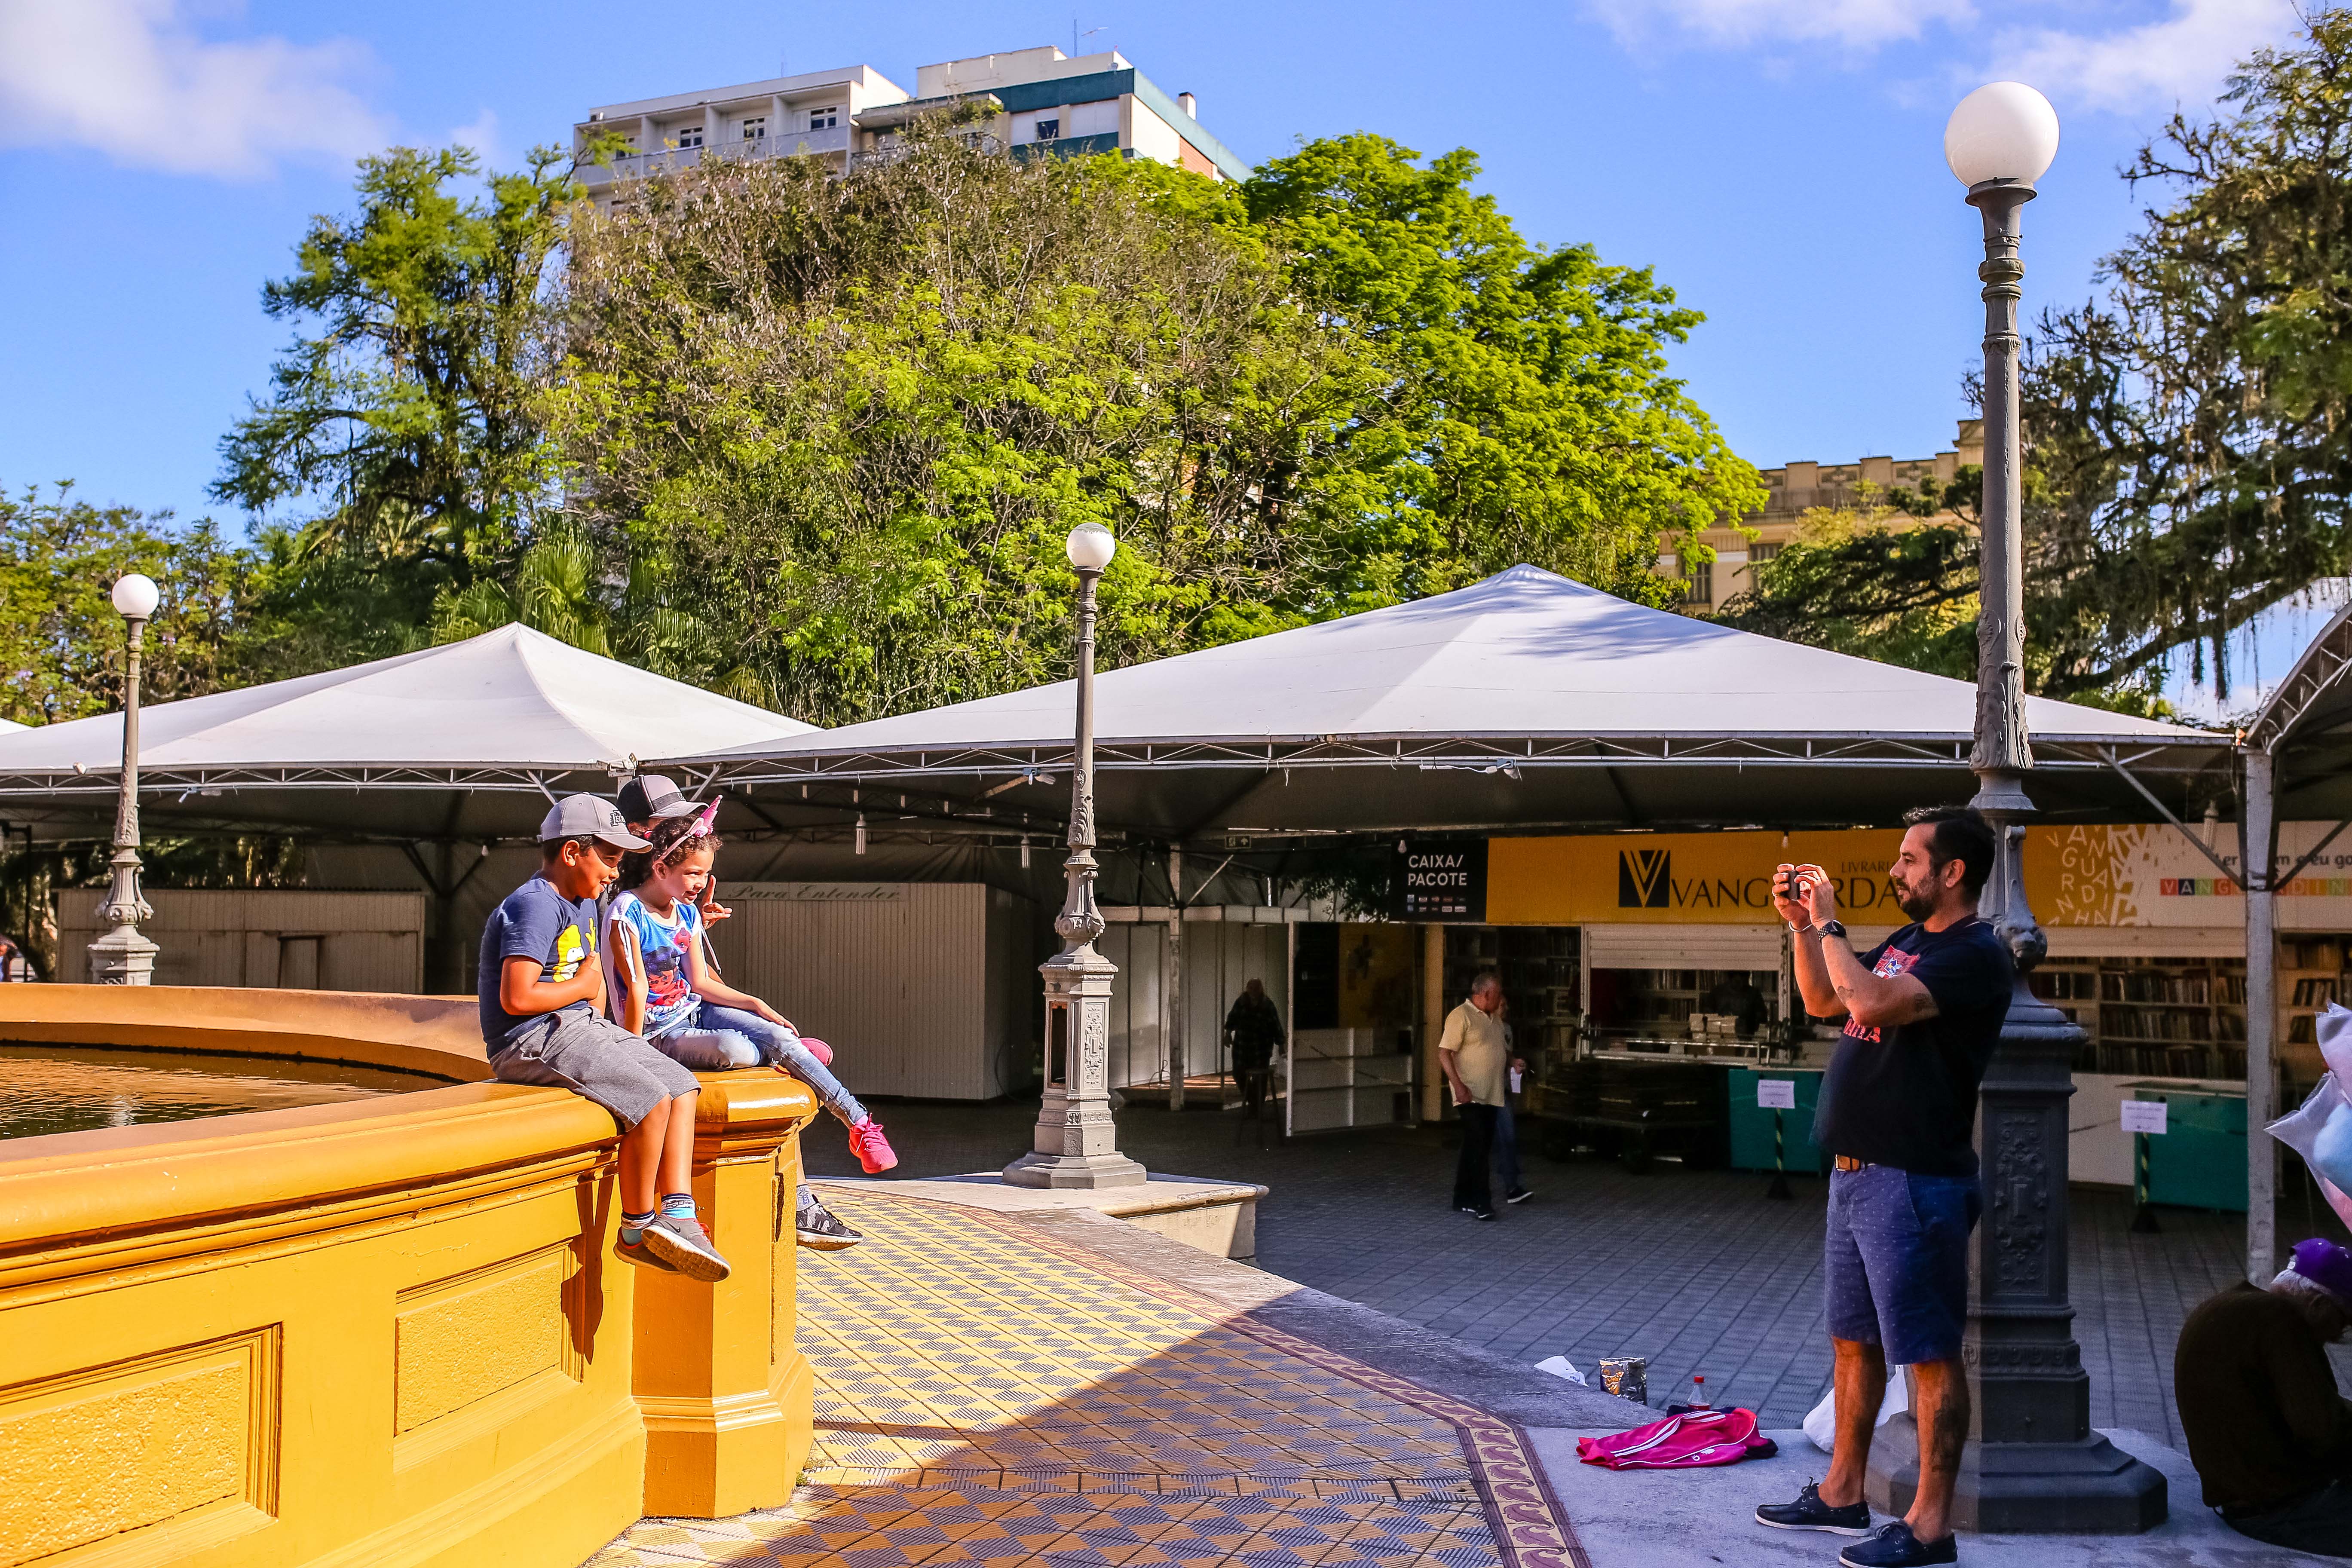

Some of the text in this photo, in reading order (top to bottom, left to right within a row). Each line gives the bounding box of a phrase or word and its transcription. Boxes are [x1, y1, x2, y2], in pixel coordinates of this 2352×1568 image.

[1409, 854, 1464, 868] CAIXA/
[1408, 873, 1467, 886] PACOTE
[1671, 877, 1900, 908] VANGRDA
